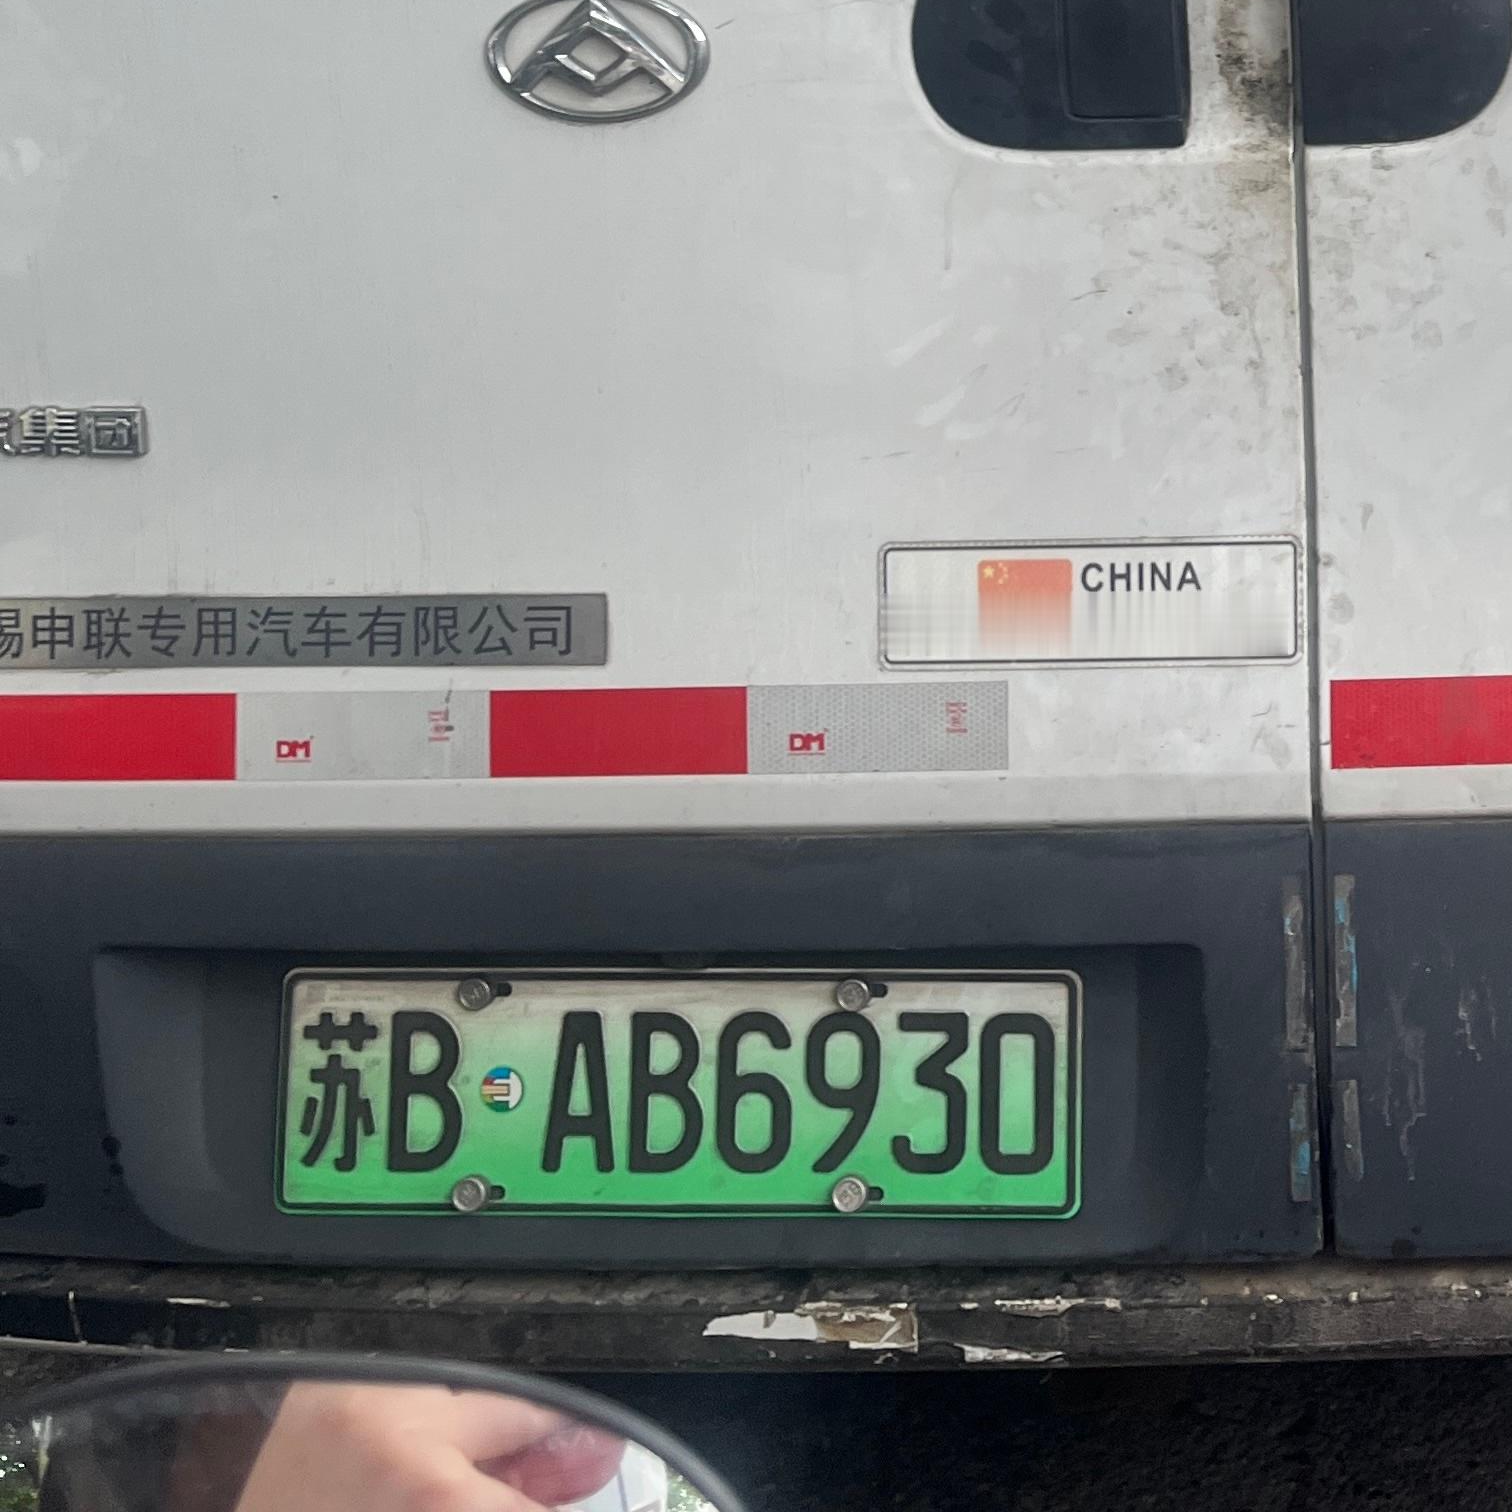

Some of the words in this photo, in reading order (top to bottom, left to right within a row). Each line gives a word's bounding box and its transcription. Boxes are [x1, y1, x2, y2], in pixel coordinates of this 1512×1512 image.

[1081, 561, 1202, 593] CHINA
[276, 741, 311, 758] DM
[789, 733, 825, 751] DM
